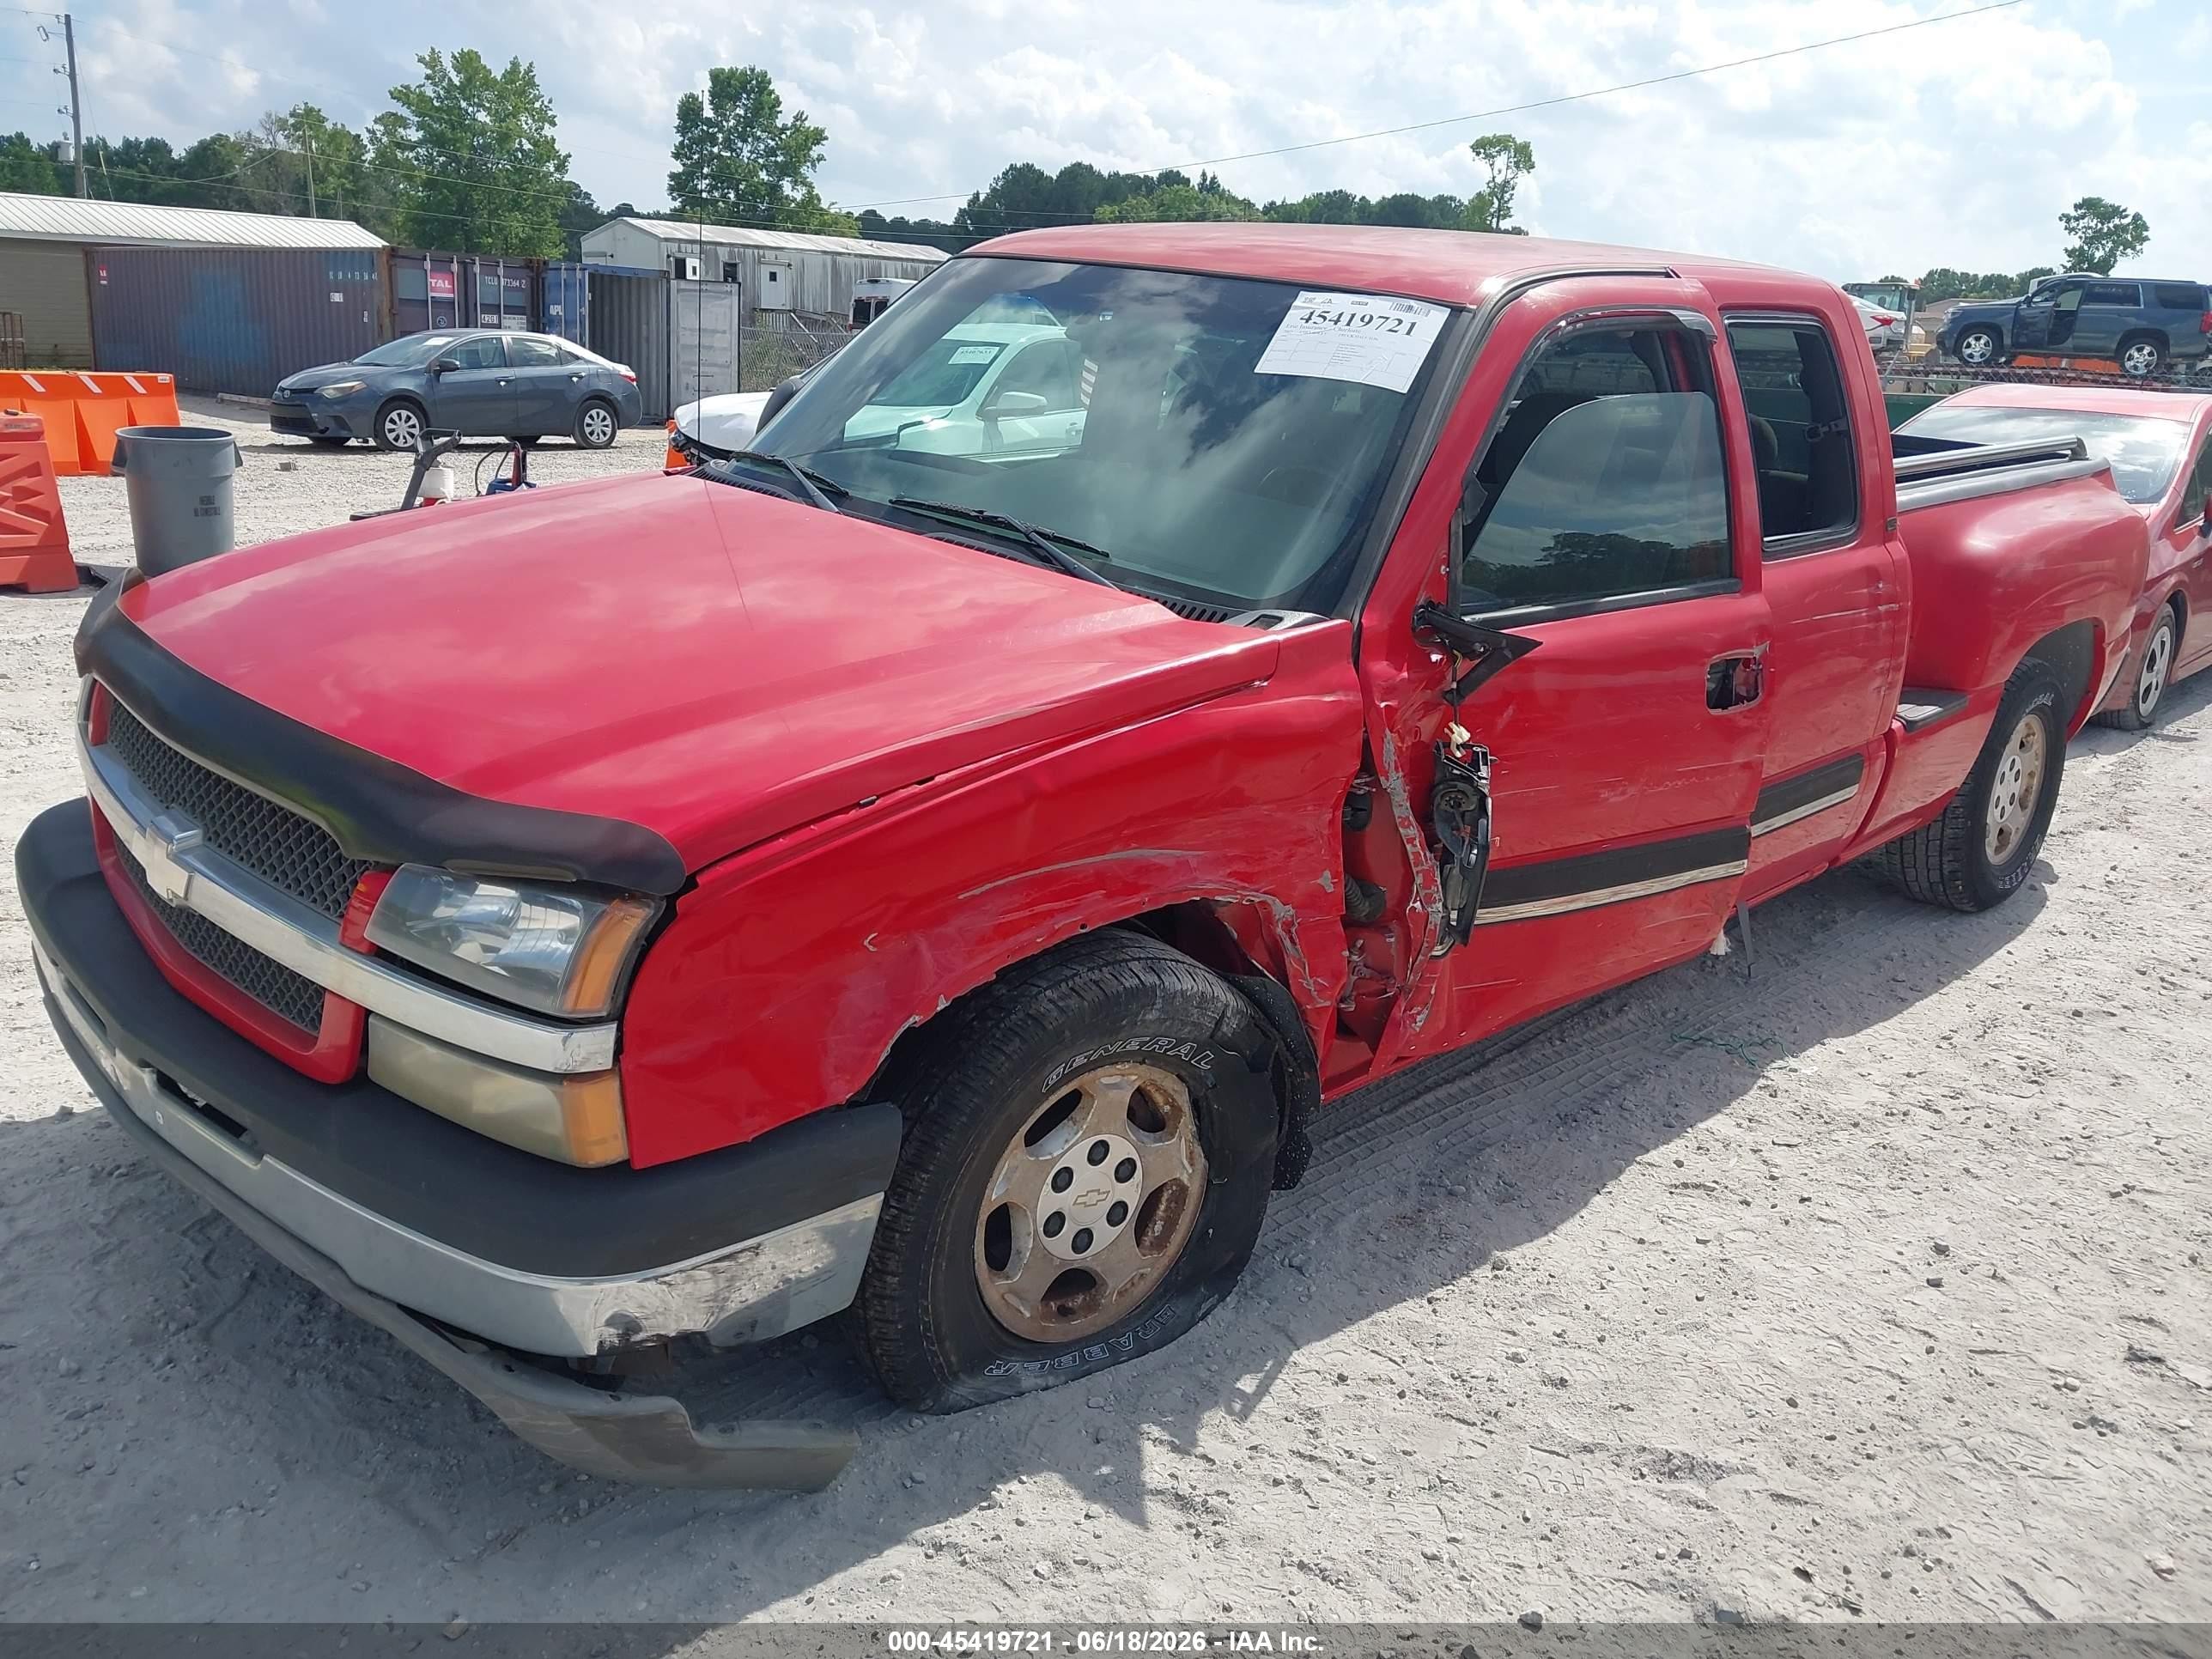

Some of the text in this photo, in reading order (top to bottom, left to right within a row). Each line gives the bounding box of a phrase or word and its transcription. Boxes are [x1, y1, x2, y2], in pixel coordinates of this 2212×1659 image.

[429, 278, 453, 288] TAL
[1299, 310, 1418, 337] 45419721
[1042, 1036, 1215, 1093] GENERAL
[984, 1304, 1177, 1376] GRABBER
